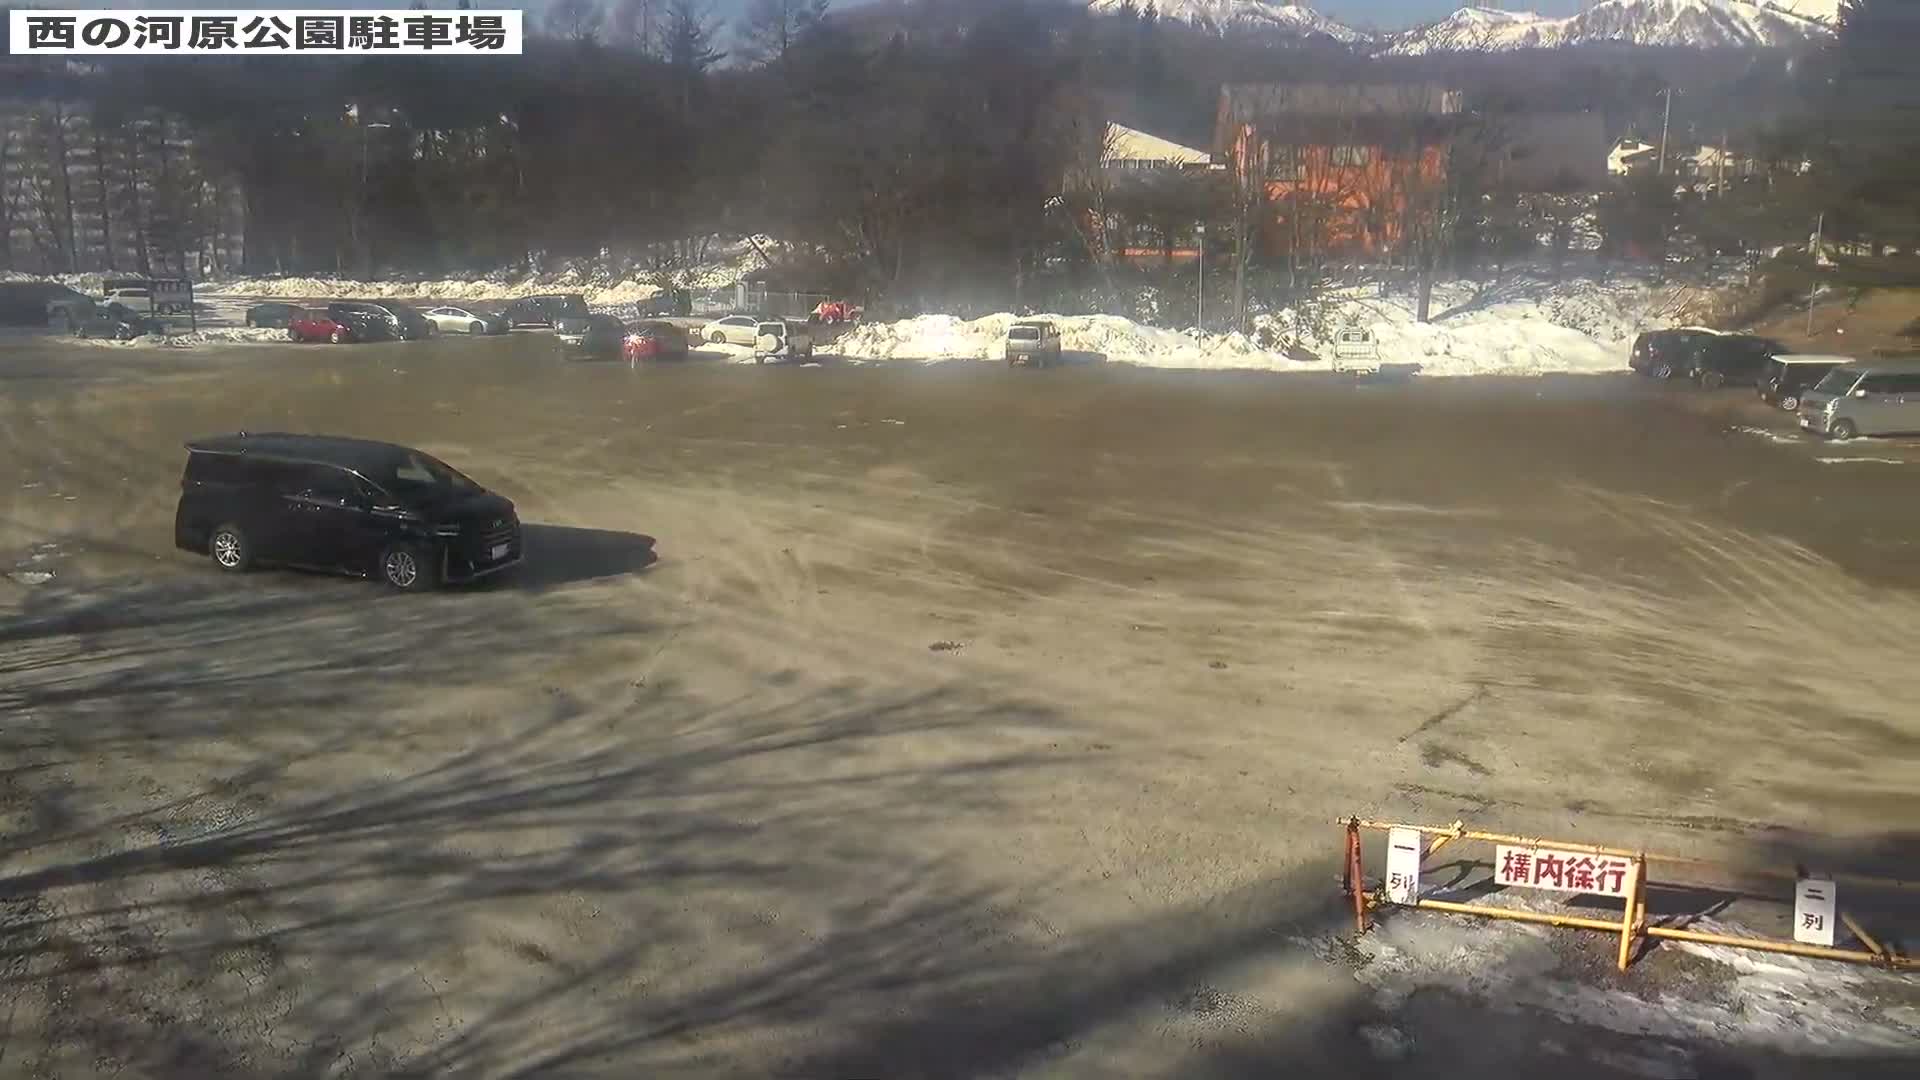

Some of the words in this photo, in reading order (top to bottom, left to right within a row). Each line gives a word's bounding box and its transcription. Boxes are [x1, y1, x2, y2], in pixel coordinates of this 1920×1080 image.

[1390, 844, 1416, 894] 一列
[1501, 850, 1627, 893] 構内徐行
[1802, 888, 1825, 931] 二列
